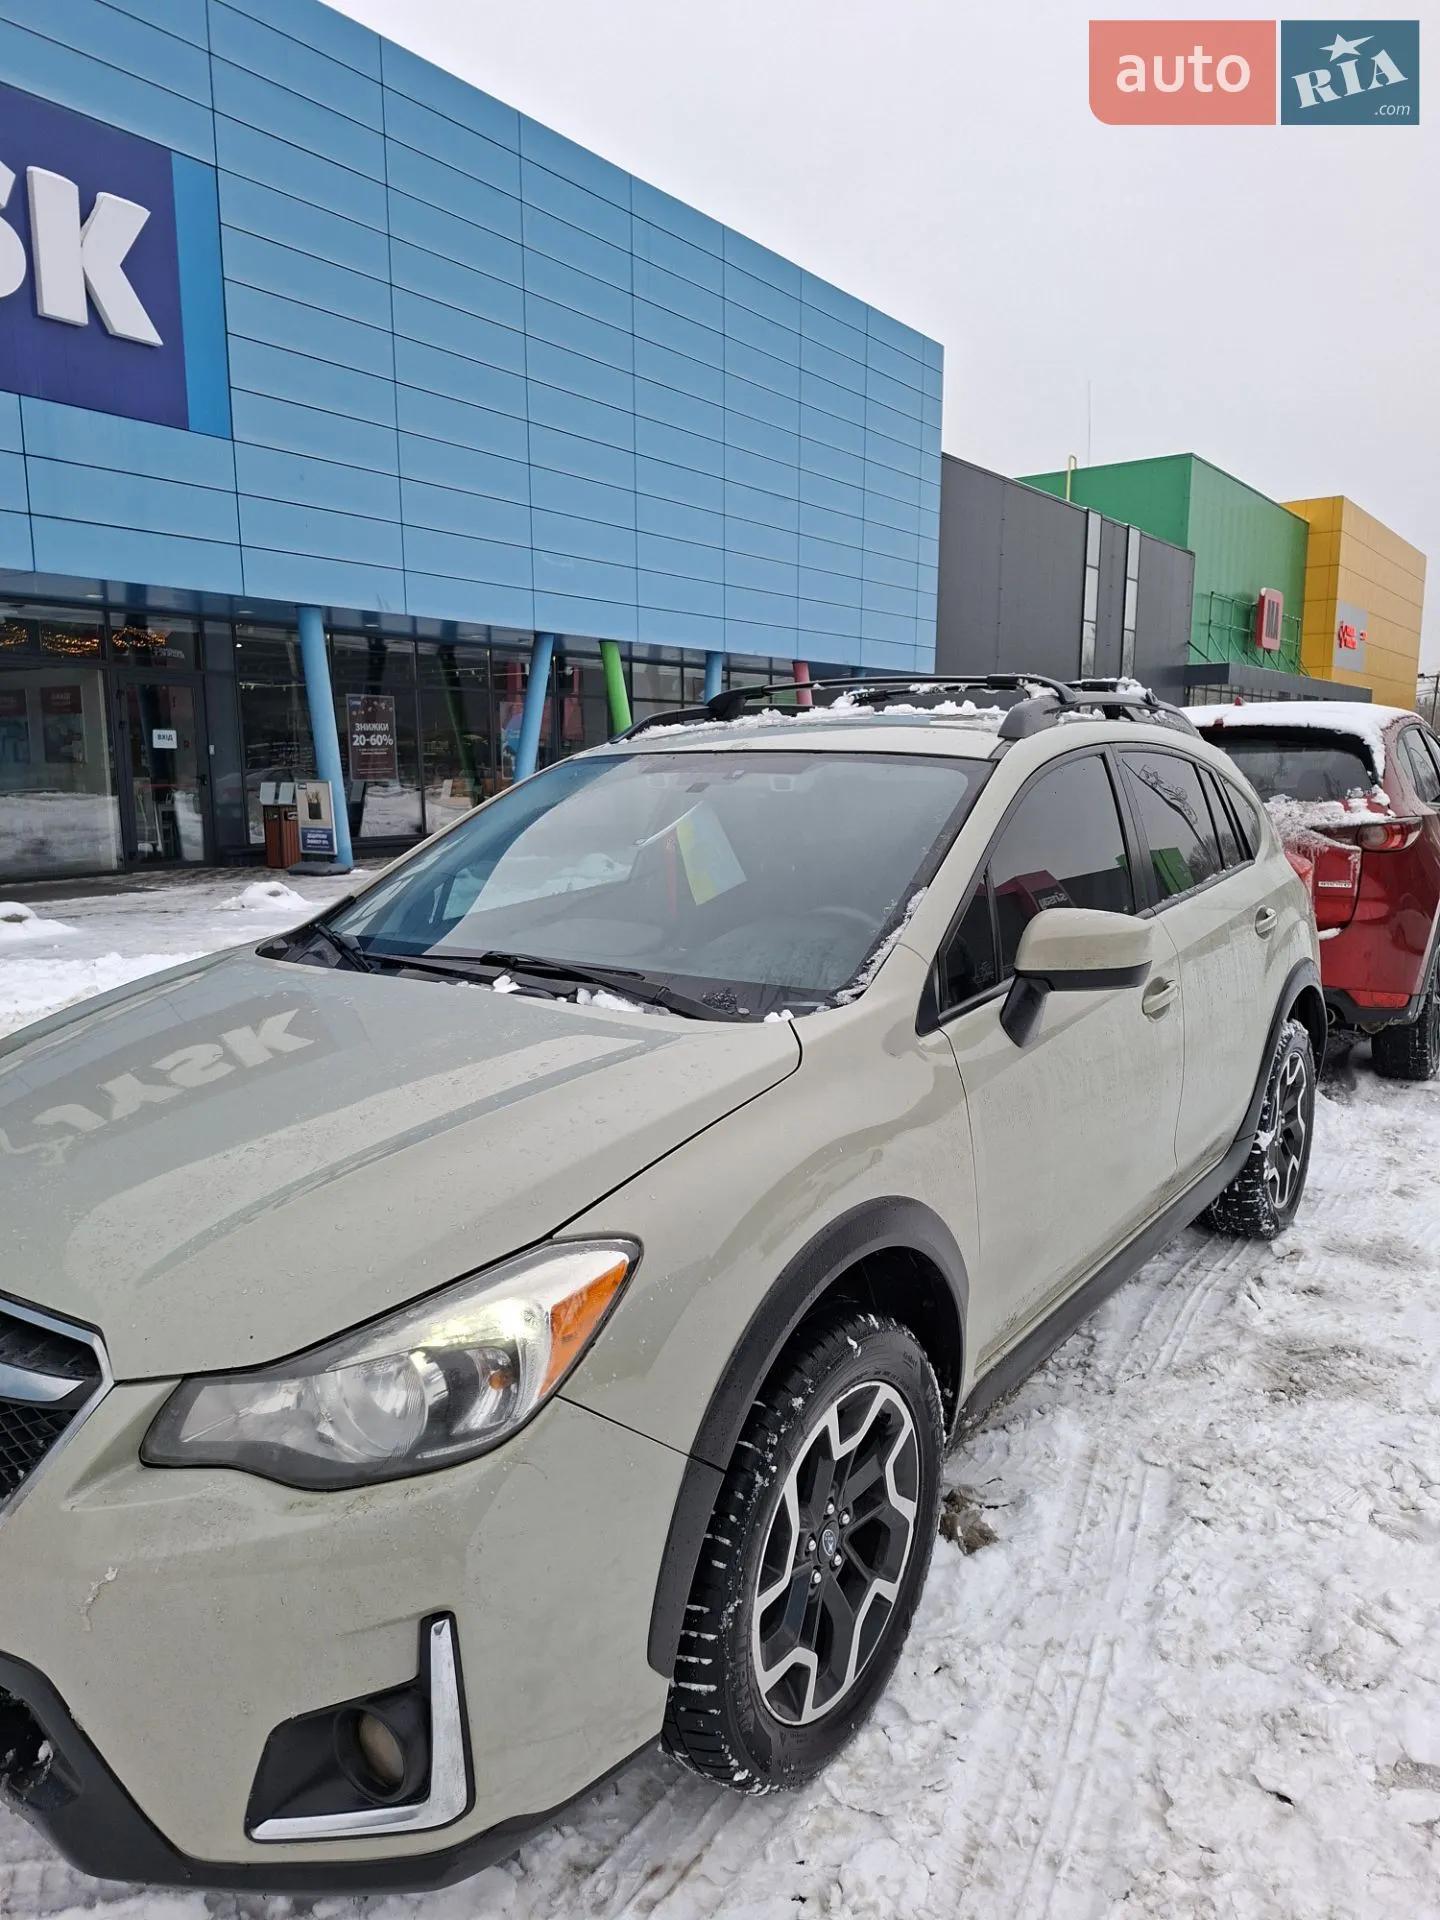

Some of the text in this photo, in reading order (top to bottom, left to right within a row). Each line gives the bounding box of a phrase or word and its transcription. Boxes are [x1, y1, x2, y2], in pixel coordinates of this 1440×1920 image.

[355, 722, 389, 731] ЗНИЖКИ
[157, 733, 174, 742] ВХІД
[353, 734, 393, 746] 20-60%
